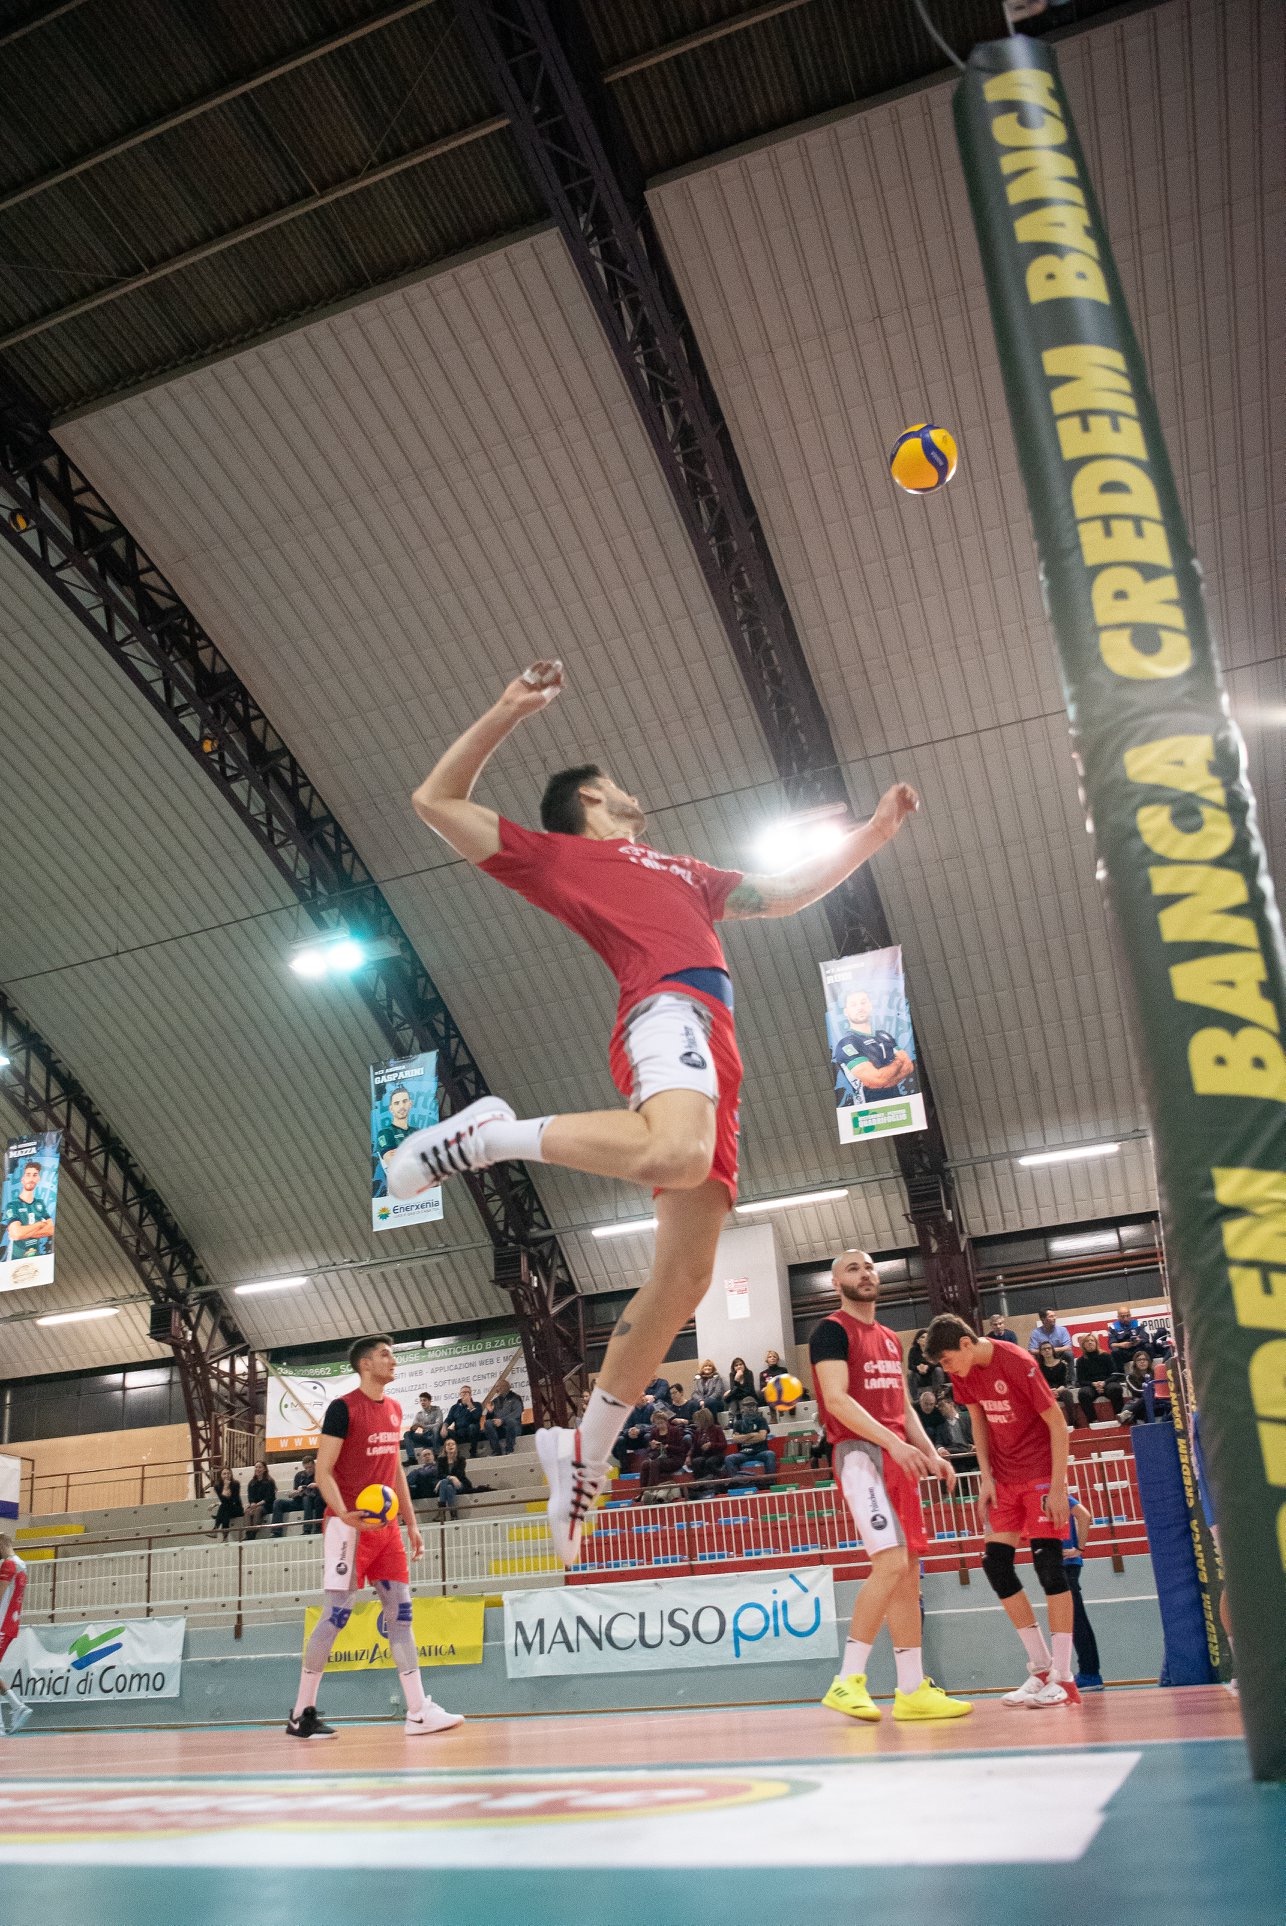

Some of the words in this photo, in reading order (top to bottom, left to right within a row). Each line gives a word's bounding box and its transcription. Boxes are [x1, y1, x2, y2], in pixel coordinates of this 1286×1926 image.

[983, 68, 1111, 305] BANCA
[1041, 344, 1193, 681] CREDEM
[1123, 734, 1286, 1103] BANCA
[386, 1383, 428, 1395] SONALIZZATI
[394, 1352, 420, 1364] OUSE
[427, 1342, 483, 1359] MONTICELLO
[479, 1358, 494, 1367] WEB
[1177, 1438, 1195, 1508] CREDEM
[514, 1604, 727, 1657] MANCUSO
[732, 1573, 821, 1658] più
[1202, 1591, 1220, 1667] CREDEM
[10, 1668, 71, 1697] Amici
[76, 1671, 94, 1695] di
[99, 1664, 166, 1694] Como
